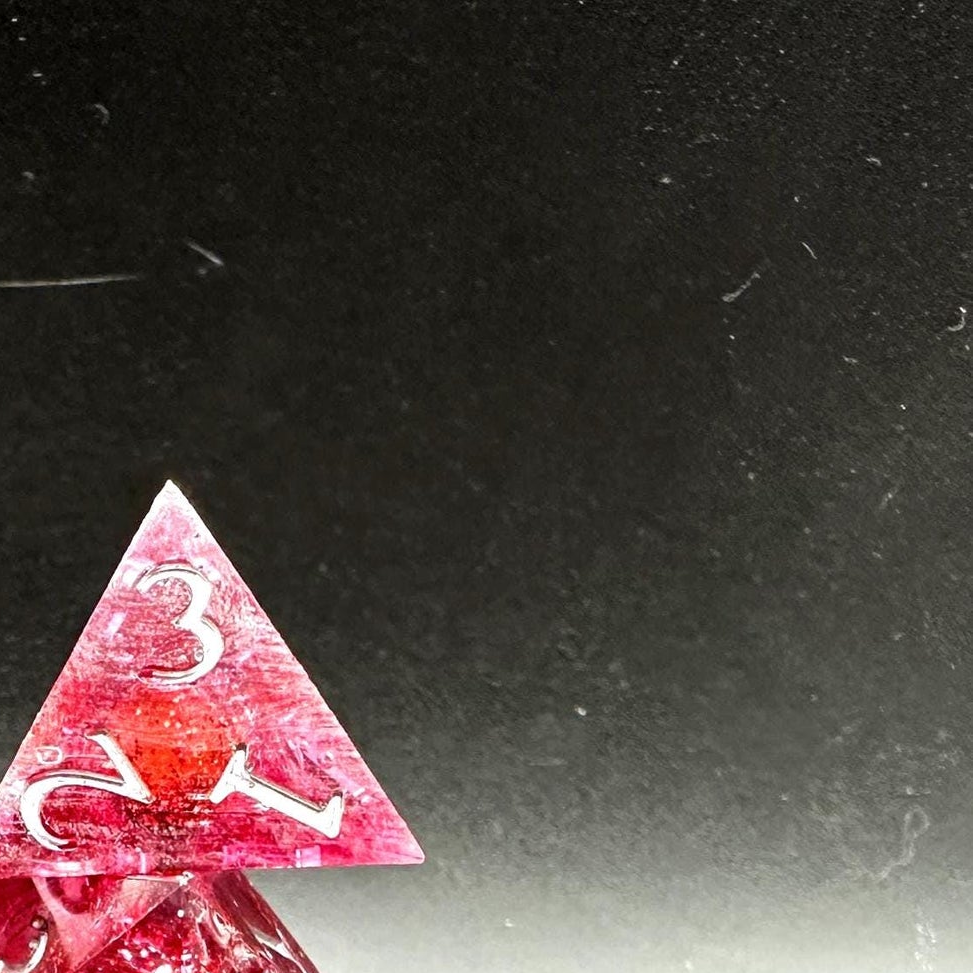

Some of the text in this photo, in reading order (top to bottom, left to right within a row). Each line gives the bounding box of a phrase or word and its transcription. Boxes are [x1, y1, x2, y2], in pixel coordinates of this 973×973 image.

[136, 560, 225, 687] 3
[20, 731, 155, 852] 2
[209, 742, 345, 839] 1
